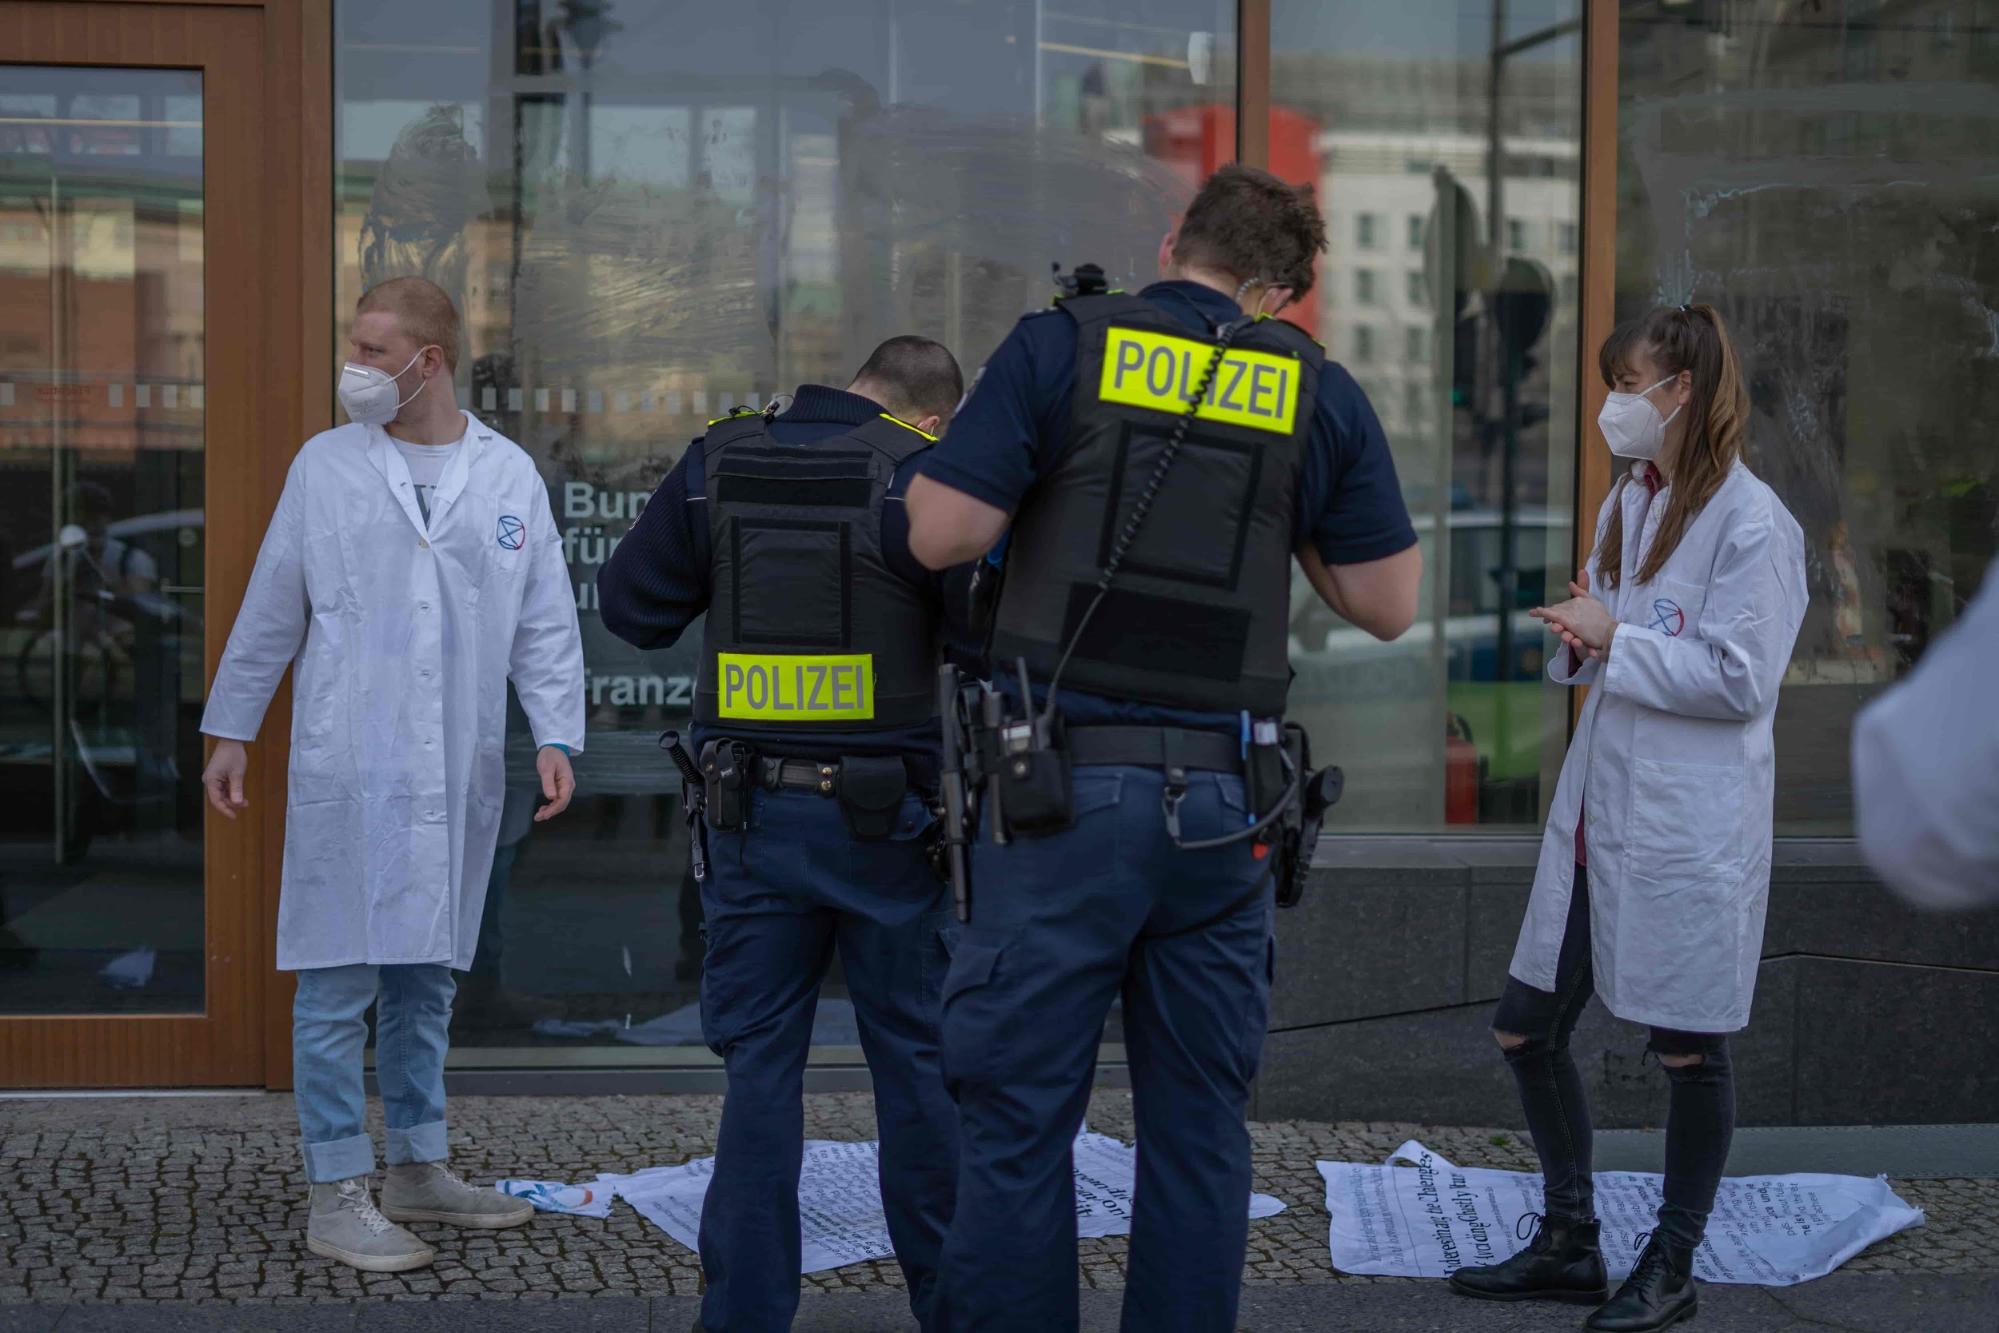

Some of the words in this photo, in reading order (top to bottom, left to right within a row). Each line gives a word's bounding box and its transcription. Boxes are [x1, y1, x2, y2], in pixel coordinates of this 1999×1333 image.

[1113, 339, 1288, 420] POLIZEI
[585, 667, 696, 705] ranz
[725, 663, 865, 711] POLIZEI
